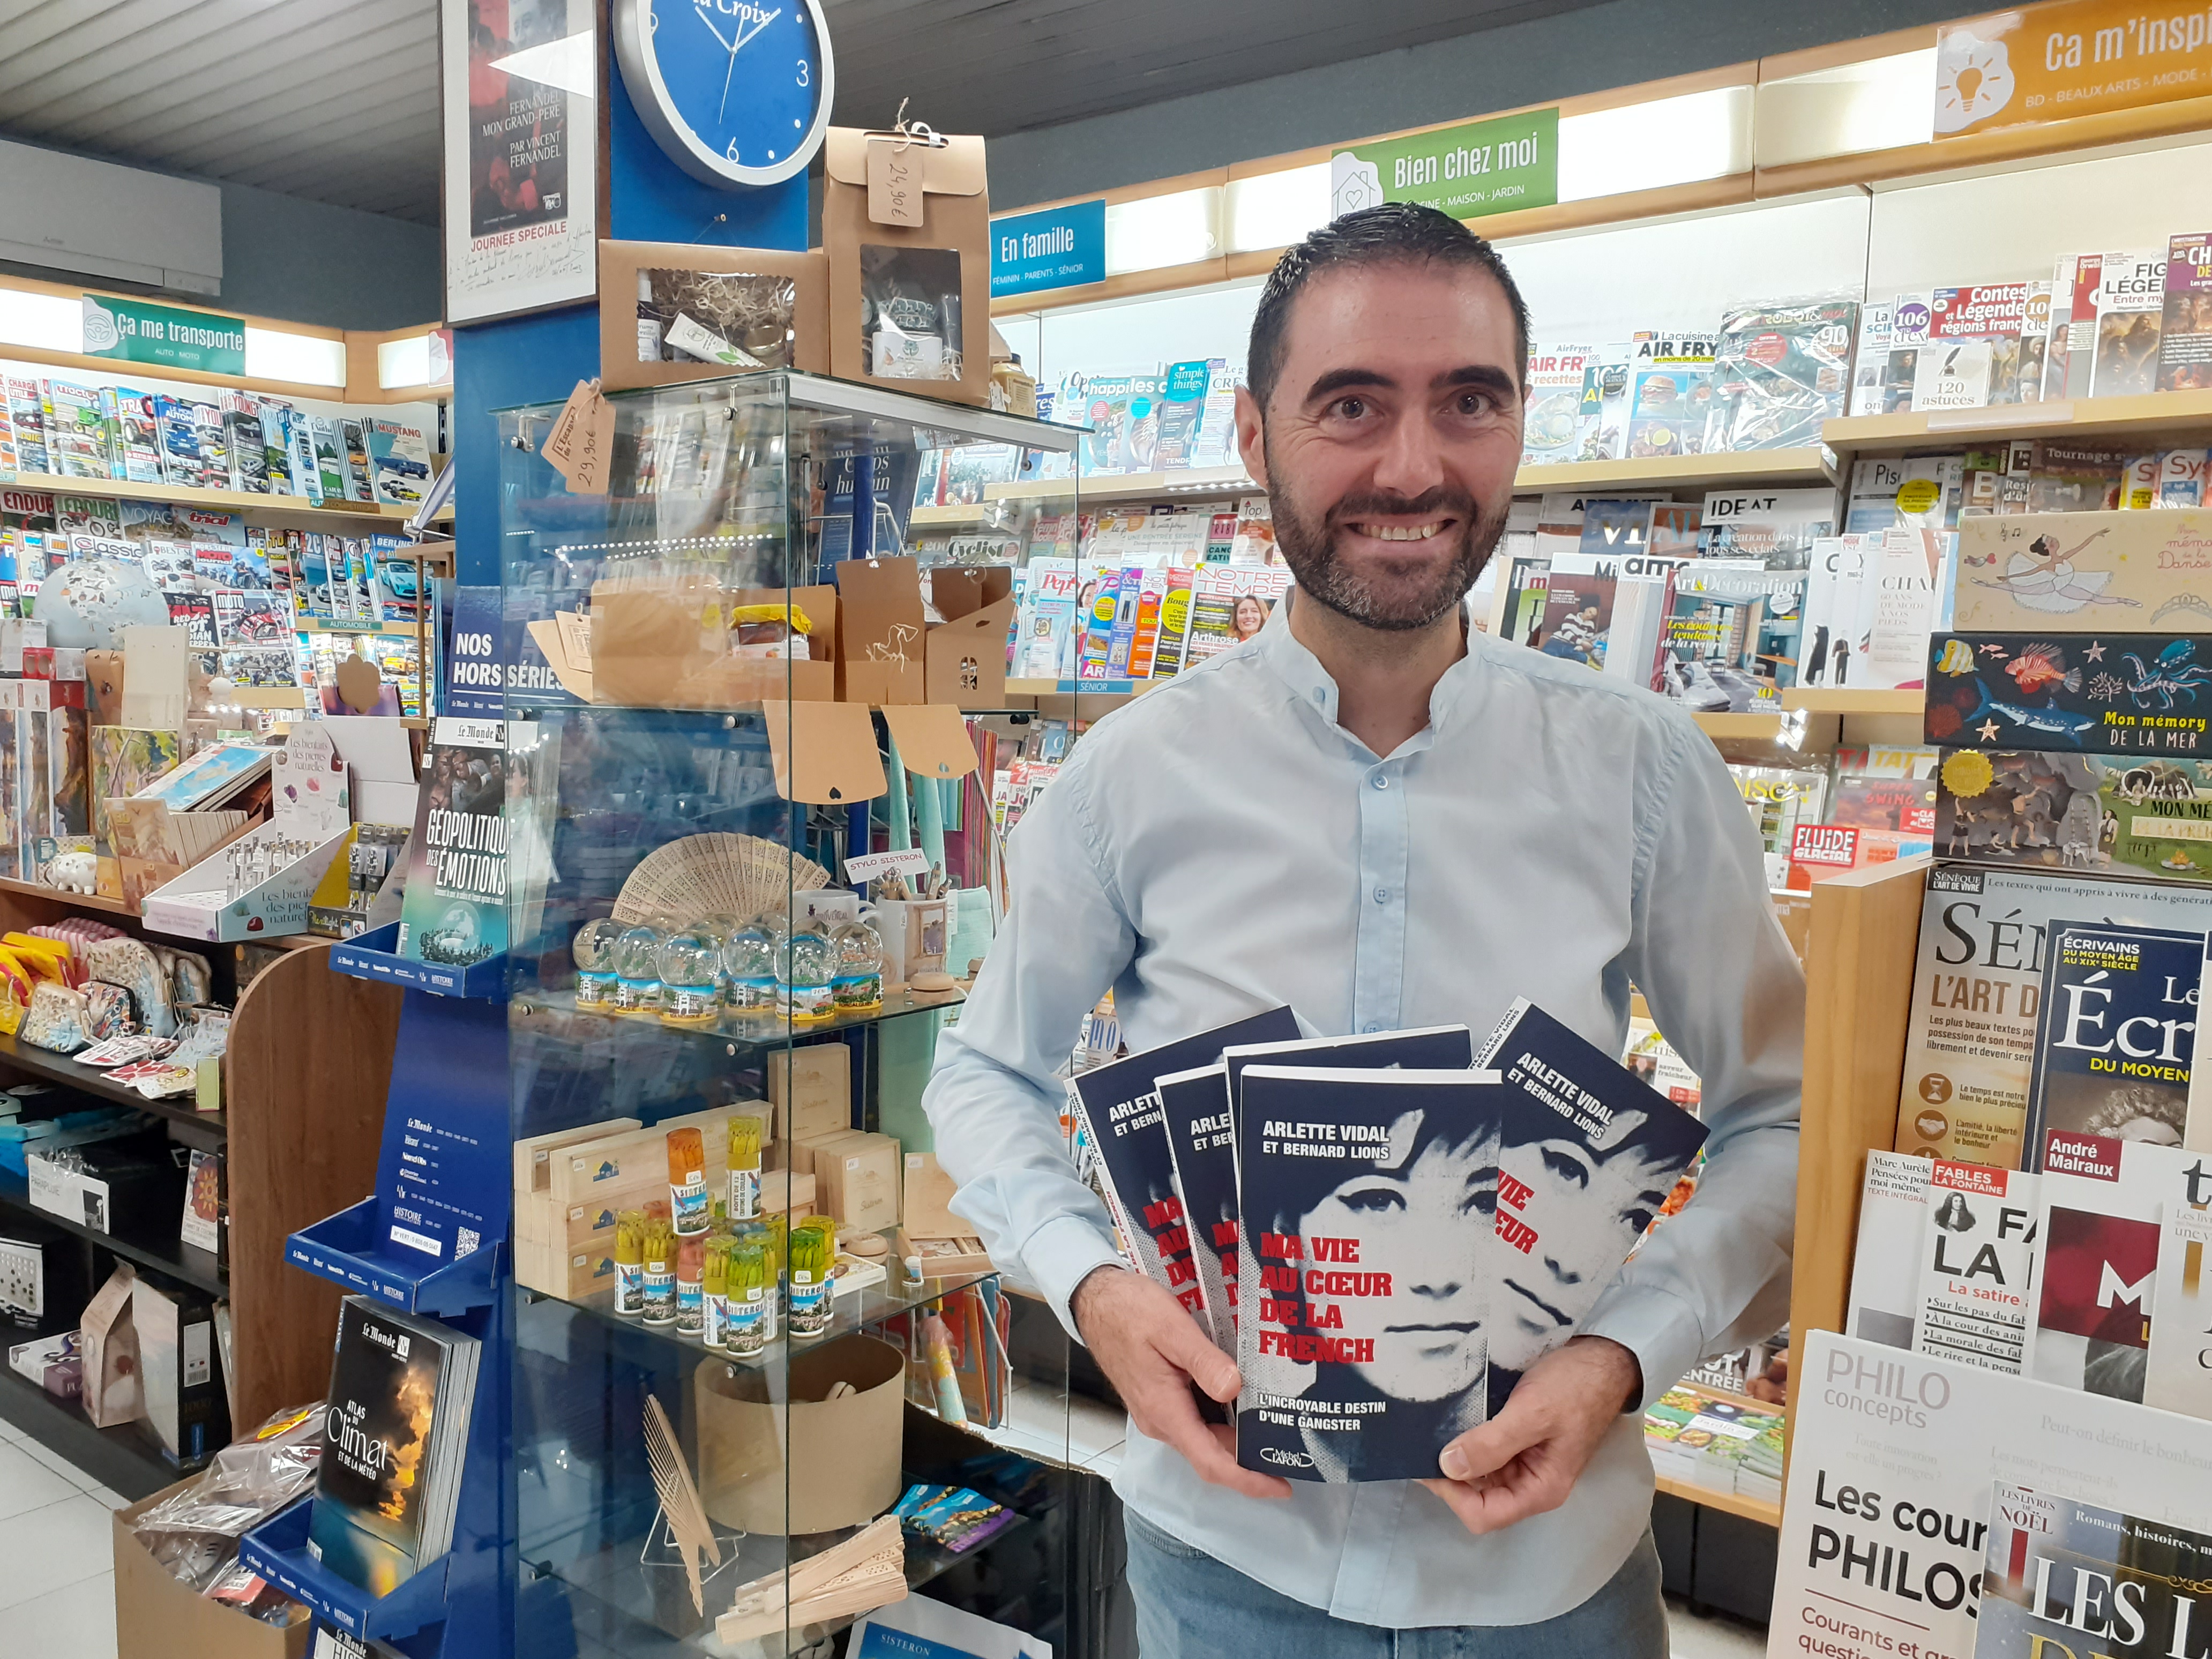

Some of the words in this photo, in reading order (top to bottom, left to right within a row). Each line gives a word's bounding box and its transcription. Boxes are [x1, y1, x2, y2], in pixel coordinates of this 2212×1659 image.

[796, 59, 809, 86] 3
[2026, 94, 2044, 108] BD
[2057, 86, 2102, 102] BEAUX
[2105, 78, 2140, 94] ARTS
[2153, 69, 2196, 86] MODE
[510, 91, 560, 115] FERNANDEL
[483, 121, 502, 136] MON
[510, 140, 525, 154] PAR
[527, 130, 561, 150] VINCENT
[726, 137, 739, 163] 6
[511, 145, 561, 168] FERNANDEL
[1395, 154, 1437, 188] Bien
[1445, 146, 1490, 181] chez
[1498, 131, 1537, 170] moi
[1448, 191, 1485, 206] MAISON
[1492, 184, 1525, 199] JARDIN
[1002, 236, 1017, 263] En
[1022, 226, 1074, 256] famille
[992, 274, 1020, 285] FÉMININ
[1025, 269, 1055, 281] PARENTS
[1058, 264, 1083, 275] SÉNIOR
[1971, 287, 2026, 303] Contes
[1896, 310, 1928, 327] 106
[1940, 322, 1986, 335] régions
[118, 313, 136, 339] Ça
[141, 320, 163, 338] me
[168, 322, 243, 351] transporte
[1662, 332, 1673, 340] La
[1676, 331, 1714, 341] cuisine
[155, 348, 174, 356] AUTO
[179, 352, 199, 360] MOTO
[1638, 342, 1673, 357] AIR
[1174, 367, 1204, 384] simple
[1174, 378, 1202, 391] things
[1534, 375, 1582, 384] recettes
[1937, 382, 1964, 394] 120
[1922, 395, 1975, 406] astuces
[378, 424, 421, 439] MUSTANG
[2047, 447, 2108, 461] Tournage
[1711, 498, 1777, 517] IDEAT
[948, 541, 1003, 558] Cyclist
[1199, 567, 1289, 585] NOTRE
[1197, 579, 1287, 598] TEMPS
[330, 621, 371, 629] AUTOMOBILE
[455, 633, 492, 656] NOS
[1192, 631, 1238, 644] Arthrose
[453, 662, 502, 686] HORS
[1080, 681, 1108, 691] SÉNIOR
[458, 724, 465, 737] Le
[466, 726, 494, 739] Monde
[2104, 712, 2135, 726] Mon
[2142, 714, 2207, 732] mémory
[2110, 729, 2127, 746] DE
[2139, 730, 2155, 746] LA
[2166, 731, 2196, 748] MER
[293, 751, 303, 759] des
[305, 752, 326, 762] pierres
[295, 761, 325, 772] naturelles
[427, 808, 509, 855] GÉOPOLITIQU
[427, 849, 438, 866] DES
[436, 847, 506, 896] ÉMOTIONS
[850, 860, 877, 870] STYLO
[880, 853, 922, 864] SISTERON
[1933, 880, 1949, 889] L'ART
[1961, 883, 1979, 892] VIVRE
[1988, 878, 2004, 888] Les
[2006, 880, 2034, 891] textes
[2036, 884, 2052, 893] qui
[2074, 886, 2105, 898] appris
[2108, 888, 2113, 897] à
[2115, 890, 2140, 899] vivre
[2143, 891, 2148, 900] à
[2151, 892, 2168, 901] des
[2062, 949, 2077, 958] DU
[2080, 950, 2115, 961] MOYEN
[2117, 951, 2139, 963] ÂGE
[2064, 937, 2140, 954] ÉCRIVAINS
[2063, 956, 2077, 965] AU
[2102, 958, 2138, 970] SIÈCLE
[2053, 970, 2195, 1063] Écr
[2090, 1057, 2117, 1073] DU
[2121, 1062, 2189, 1082] MOYEN
[1516, 1052, 1579, 1101] ARLETTE
[1576, 1088, 1613, 1126] VIDAL
[1507, 1067, 1523, 1085] ET
[1523, 1077, 1574, 1123] BERNARD
[1573, 1112, 1606, 1140] LIONS
[1262, 1120, 1338, 1142] ARLETTE
[1340, 1124, 1390, 1143] VIDAL
[1262, 1141, 1279, 1155] ET
[1283, 1142, 1346, 1159] BERNARD
[1350, 1145, 1389, 1160] LIONS
[2050, 1138, 2098, 1159] André
[1935, 1165, 1992, 1184] FABLES
[2049, 1153, 2114, 1177] Malraux
[1934, 1175, 1948, 1186] LA
[1951, 1177, 2004, 1195] FONTAINE
[1260, 1232, 1305, 1262] MA
[1311, 1236, 1360, 1264] VIE
[1259, 1266, 1298, 1294] AU
[1305, 1269, 1393, 1297] CŒUR
[1948, 1280, 1967, 1296] La
[1973, 1284, 2021, 1306] satire
[1259, 1298, 1298, 1328] DE
[1305, 1302, 1343, 1329] LA
[362, 1322, 369, 1336] Le
[370, 1325, 395, 1348] Monde
[1259, 1330, 1375, 1363] FRENCH
[1826, 1347, 1951, 1411] PHILO
[347, 1400, 365, 1419] ATLAS
[1259, 1393, 1342, 1415] L'INCROYABLE
[1344, 1399, 1386, 1414] DESTIN
[1824, 1387, 1927, 1430] concepts
[353, 1416, 358, 1425] DU
[1259, 1410, 1294, 1426] D'UNE
[1298, 1415, 1361, 1432] GANGSTER
[327, 1407, 387, 1470] Climat
[1272, 1455, 1302, 1468] LAFON
[1275, 1448, 1300, 1460] Michel
[338, 1451, 343, 1461] ET
[344, 1455, 350, 1466] DE
[351, 1459, 357, 1471] LA
[358, 1461, 376, 1481] MÉTÉO
[1814, 1469, 1881, 1523] Les
[1999, 1504, 2053, 1536] NOËL
[2076, 1509, 2132, 1536] Romans,
[2135, 1525, 2196, 1554] histoires,
[880, 1633, 931, 1656] SISTERON
